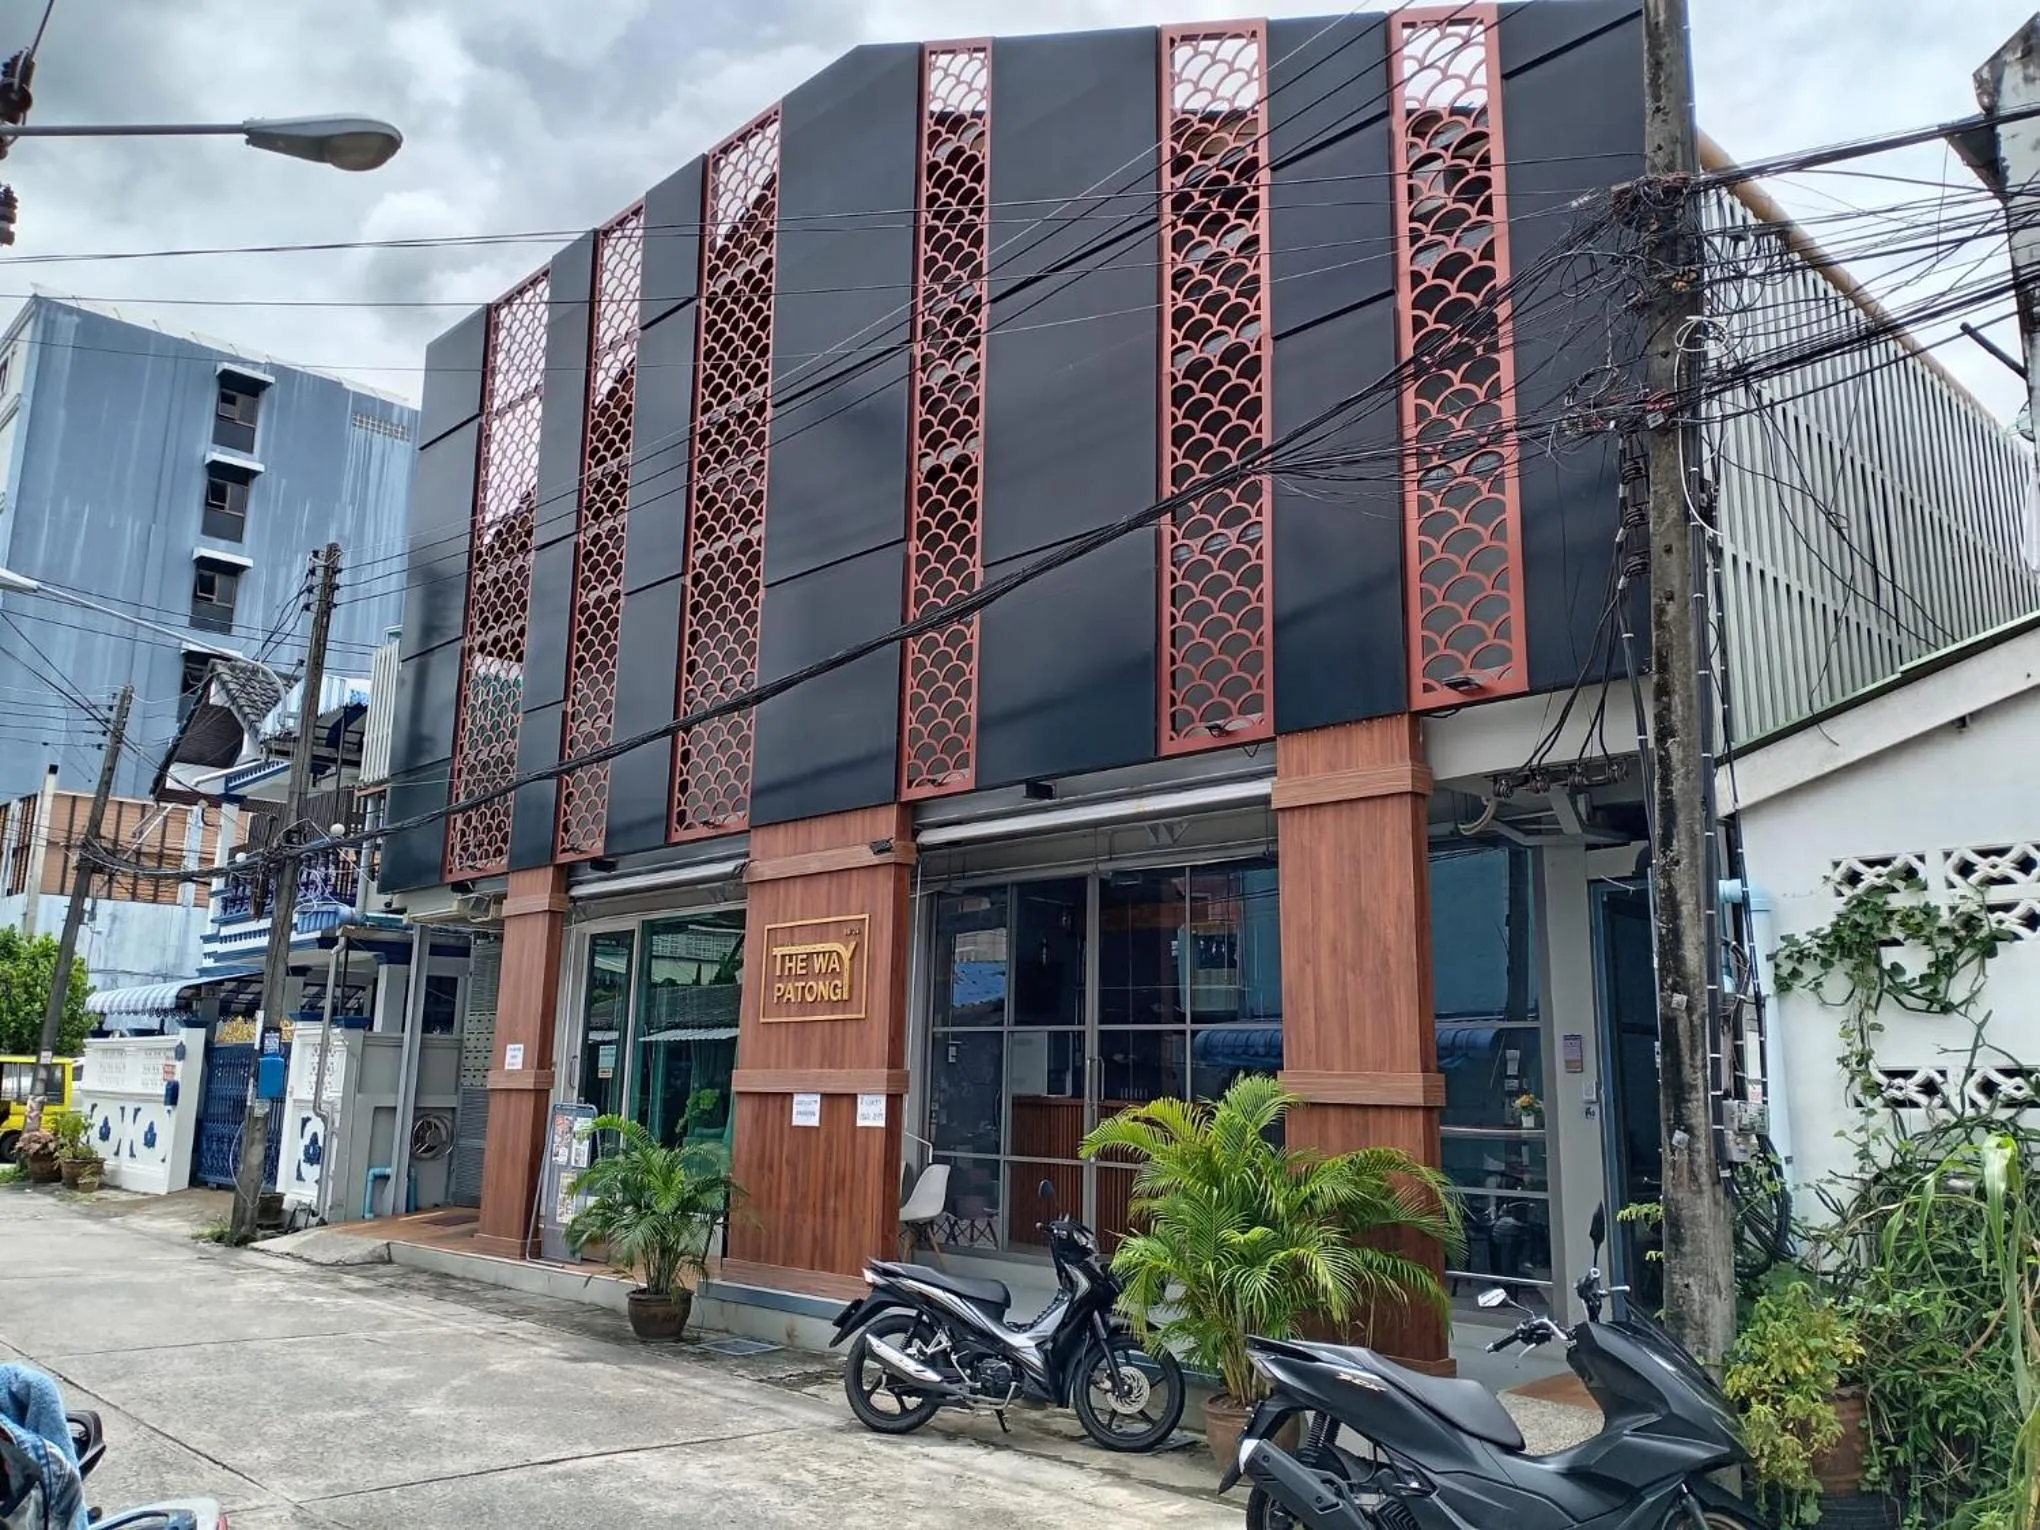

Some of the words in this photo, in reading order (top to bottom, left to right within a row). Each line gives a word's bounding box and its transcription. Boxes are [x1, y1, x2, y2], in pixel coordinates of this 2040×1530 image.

[772, 947, 808, 976] THE
[813, 941, 857, 1000] WAY
[773, 980, 842, 1004] PATONG
